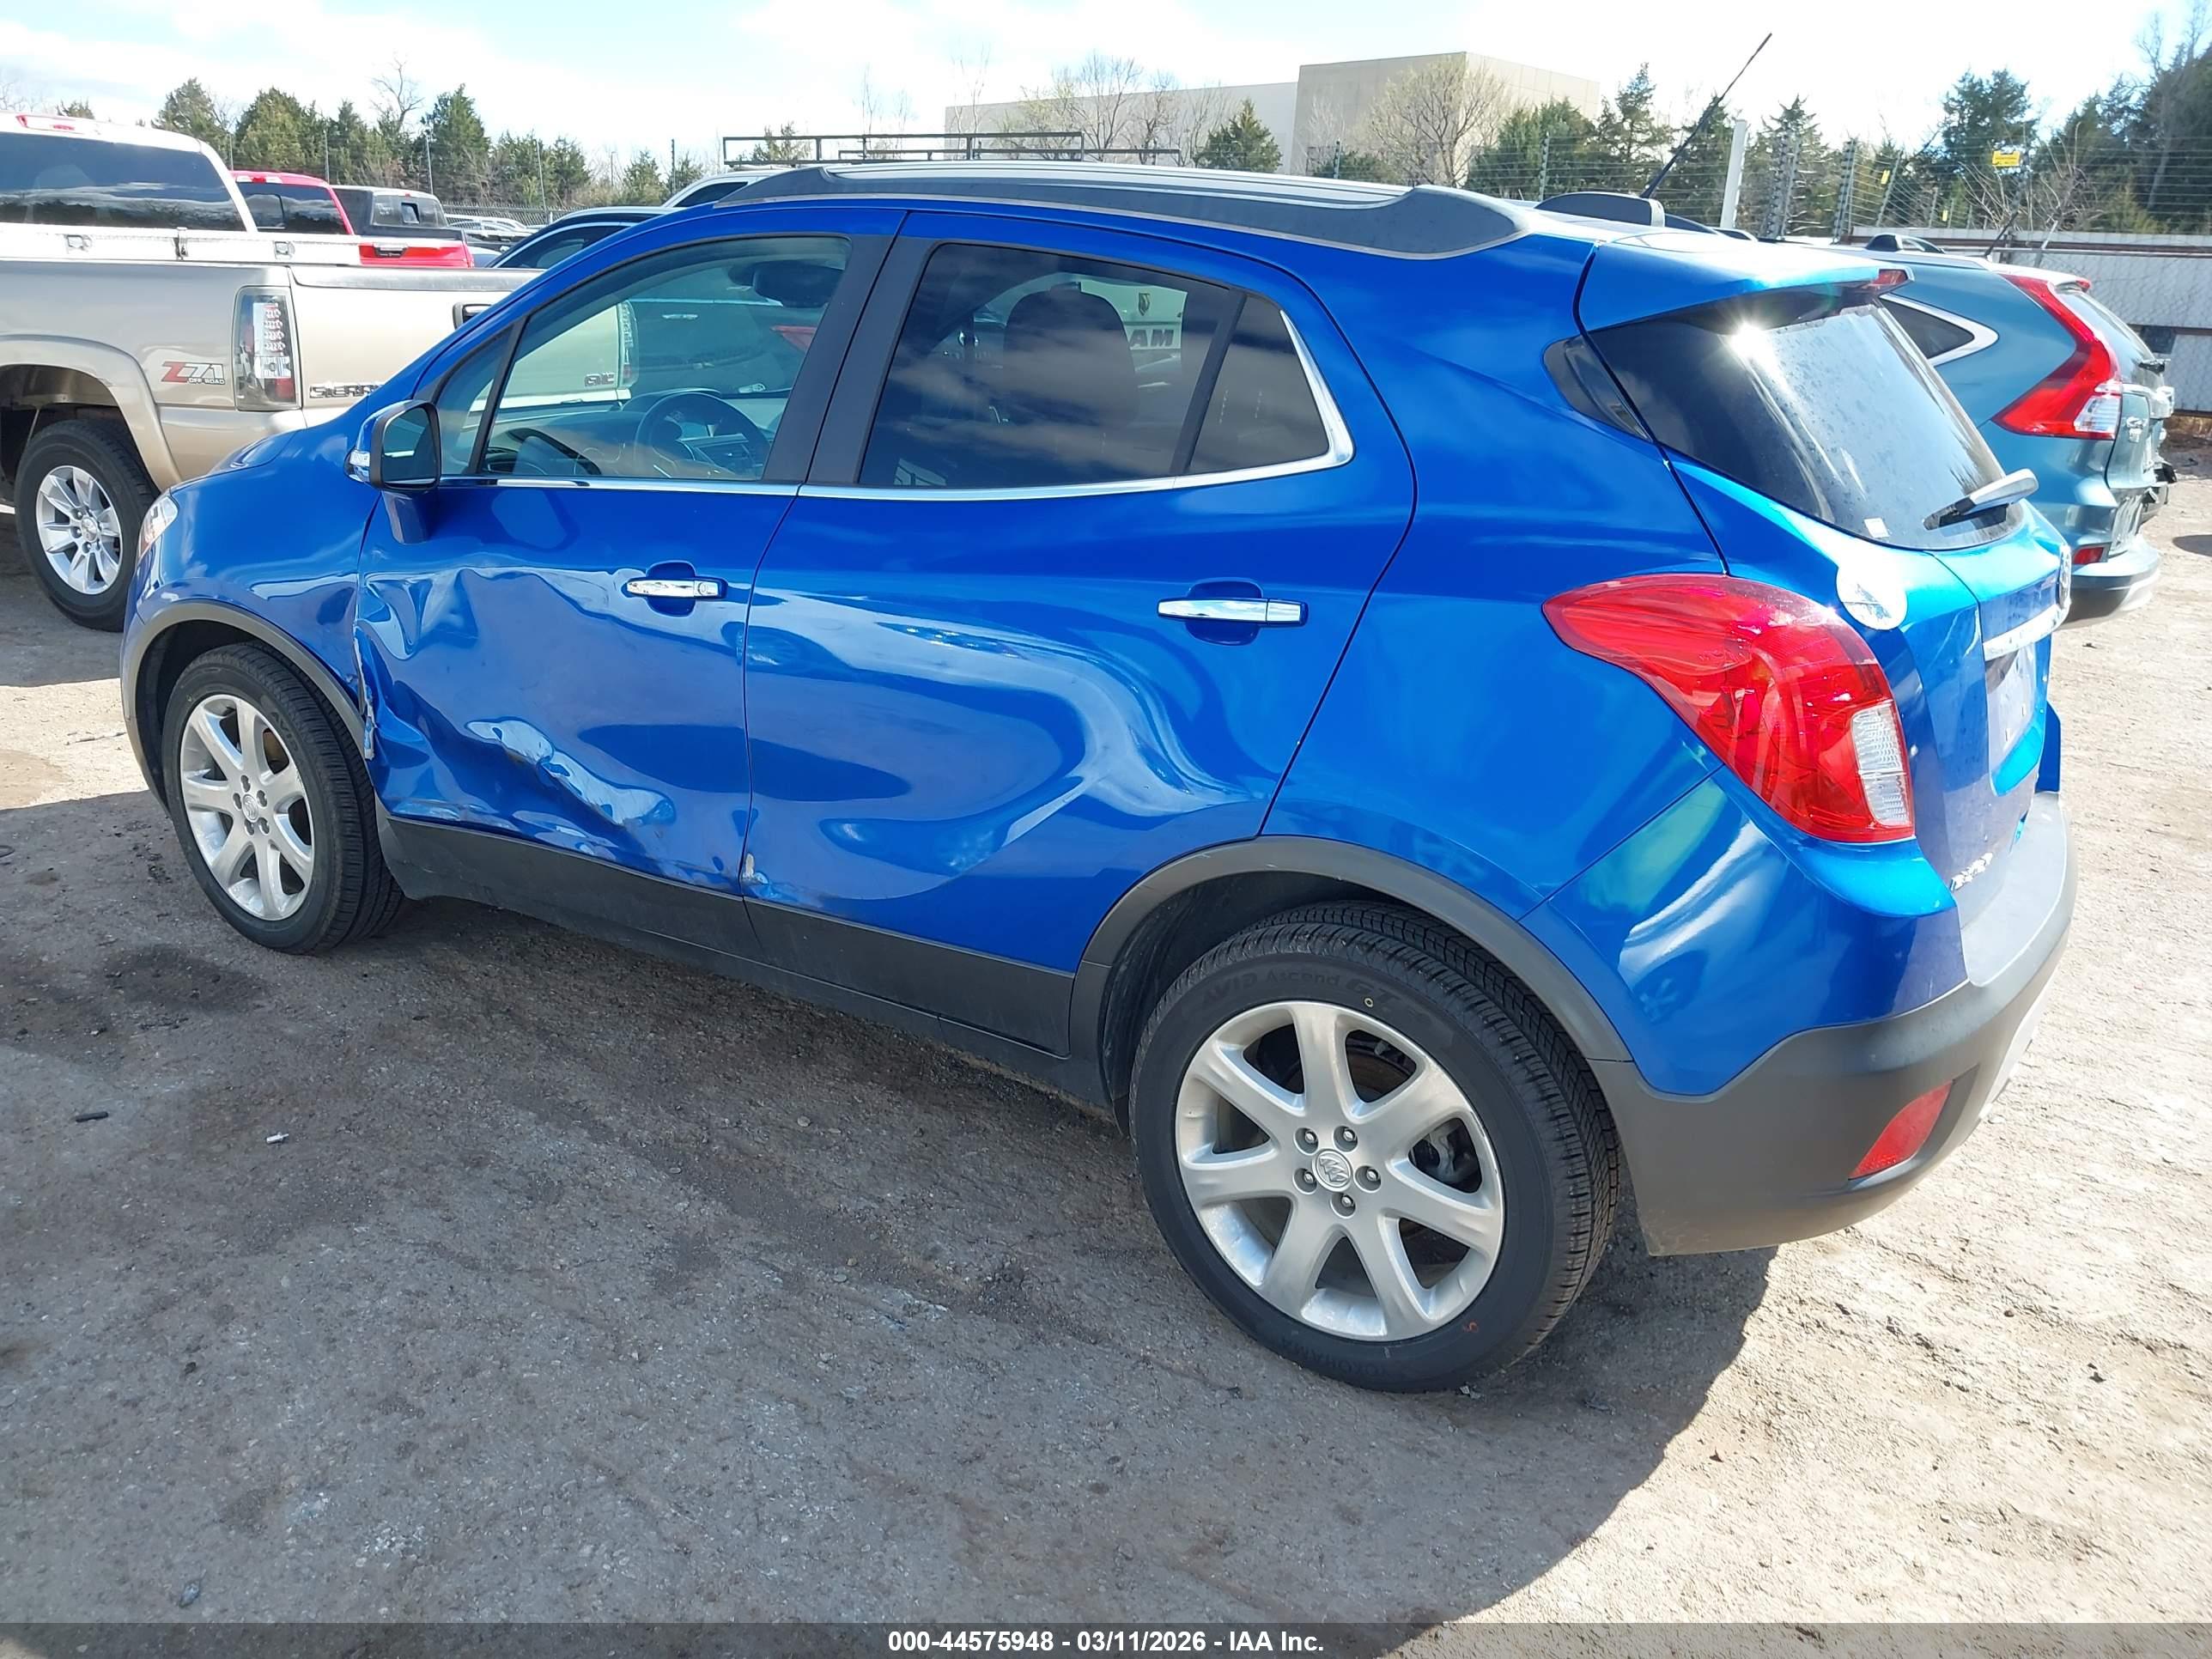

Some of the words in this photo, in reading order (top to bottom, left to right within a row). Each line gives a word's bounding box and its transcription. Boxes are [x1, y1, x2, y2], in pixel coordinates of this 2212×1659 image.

[161, 361, 225, 383] Z71
[309, 383, 383, 399] SIERR
[1264, 968, 1340, 988] Ascend
